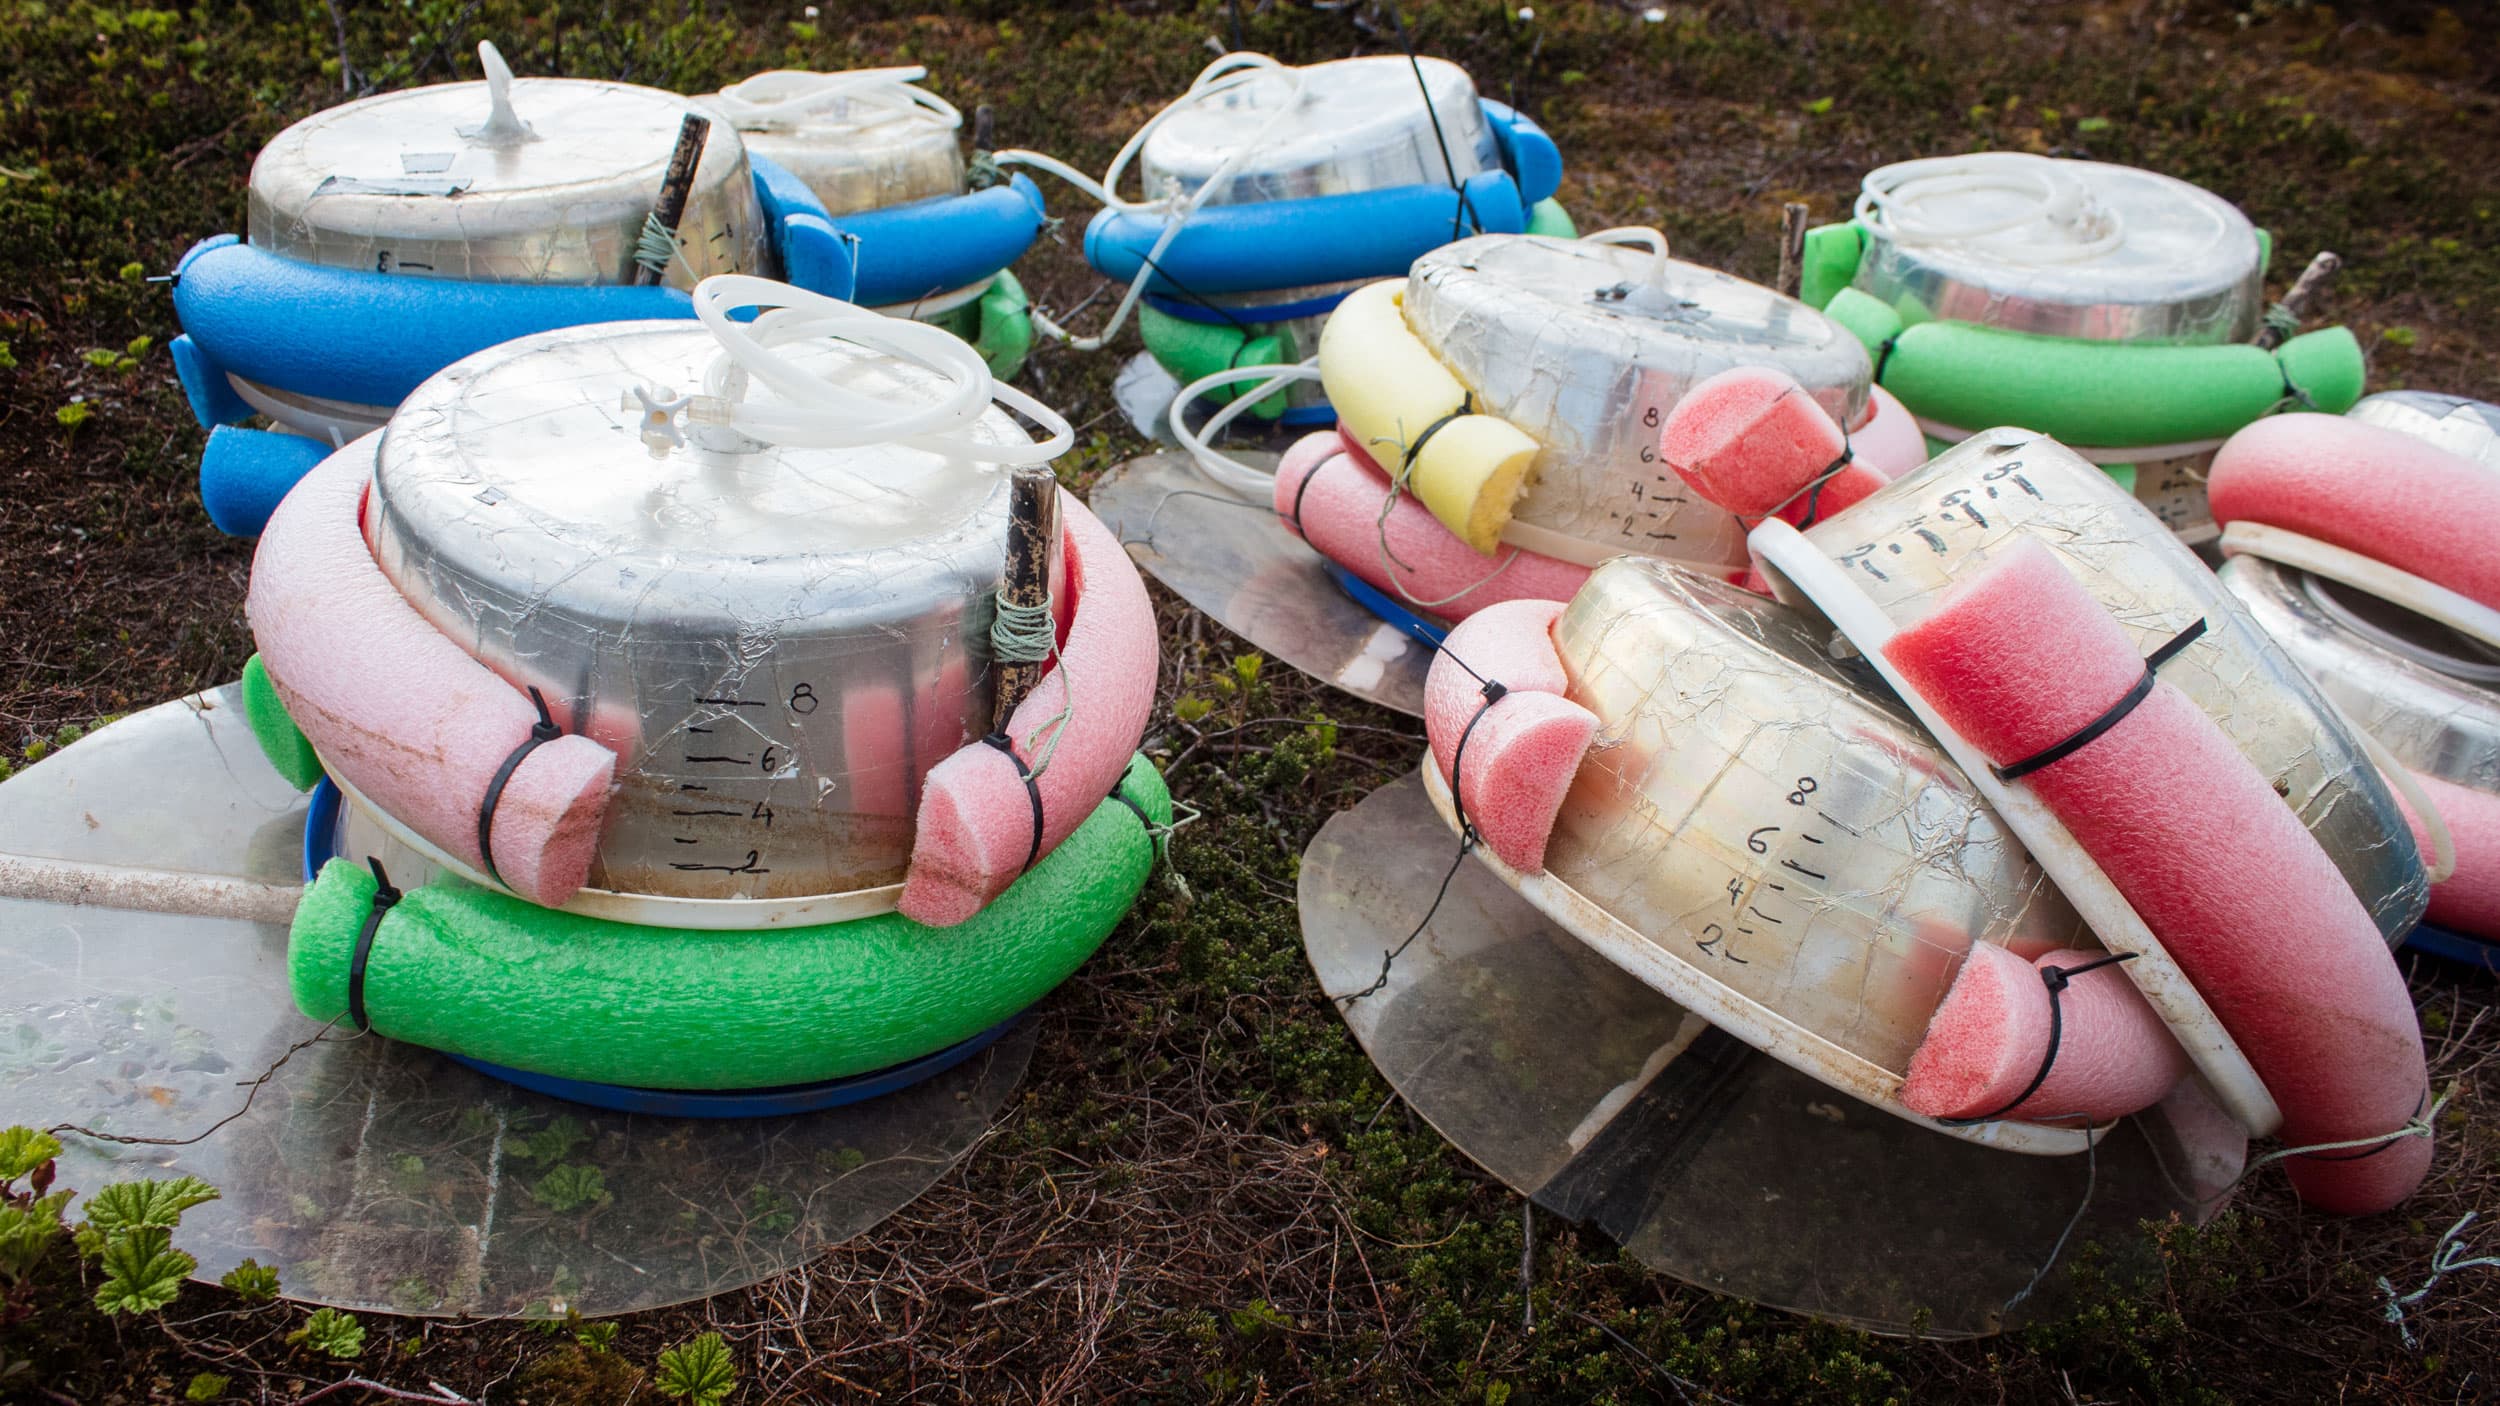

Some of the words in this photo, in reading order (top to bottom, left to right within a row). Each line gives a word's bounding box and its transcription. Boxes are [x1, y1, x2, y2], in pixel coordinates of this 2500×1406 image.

[1643, 407, 1659, 428] 8
[1640, 445, 1654, 463] 6
[1631, 480, 1643, 502] 4
[1939, 488, 1971, 507] 6
[1622, 515, 1634, 537] 2
[790, 682, 819, 715] 8
[761, 747, 776, 772] 6
[1786, 776, 1818, 806] 8
[751, 801, 775, 827] 4
[1747, 826, 1781, 855] 6
[735, 850, 770, 875] 2
[1726, 877, 1744, 906] 4
[1695, 923, 1723, 957] 2
